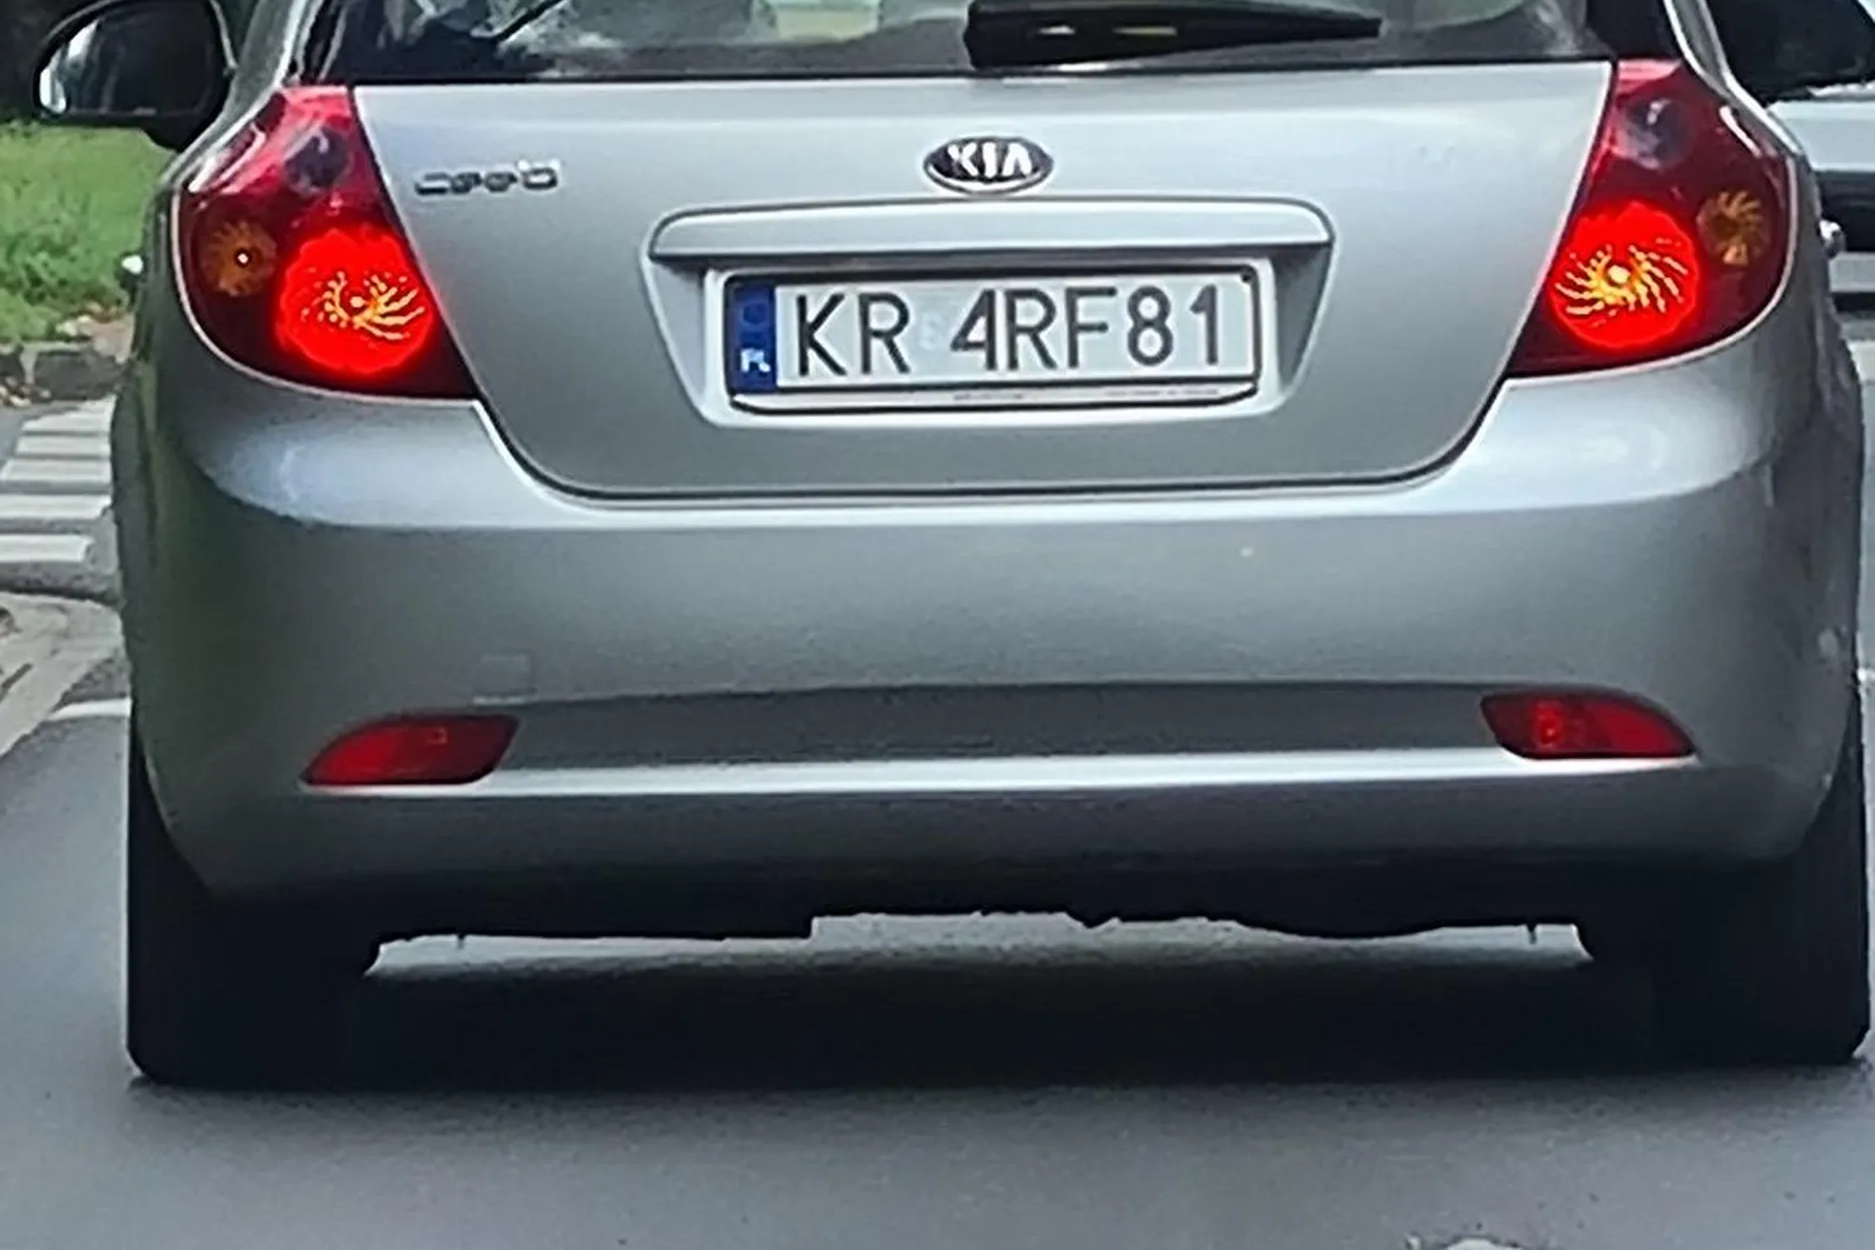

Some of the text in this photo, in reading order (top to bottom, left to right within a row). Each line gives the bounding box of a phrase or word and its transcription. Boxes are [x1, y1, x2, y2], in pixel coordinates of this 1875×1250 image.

[947, 141, 1033, 177] KIA
[796, 283, 1220, 377] KR 4RF81
